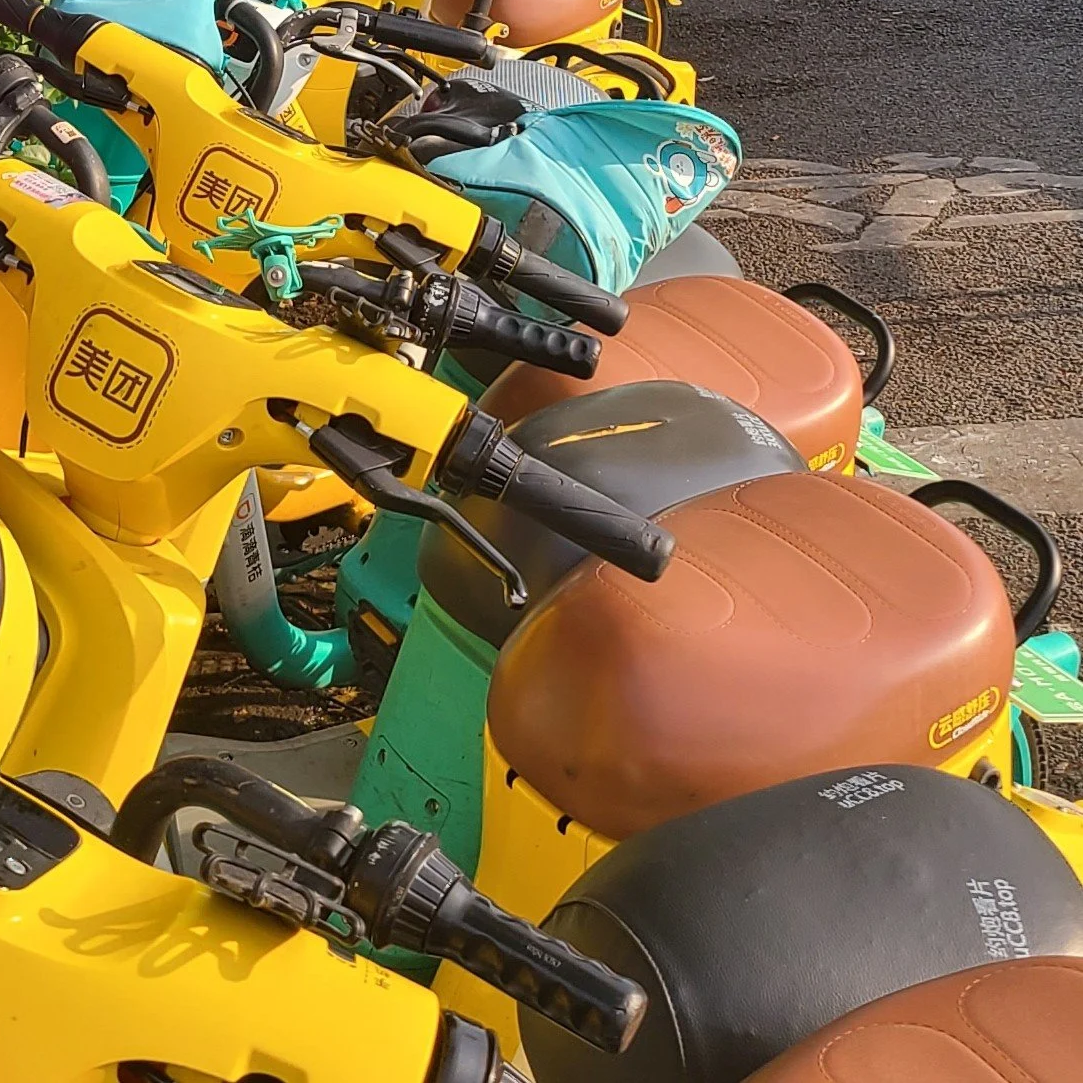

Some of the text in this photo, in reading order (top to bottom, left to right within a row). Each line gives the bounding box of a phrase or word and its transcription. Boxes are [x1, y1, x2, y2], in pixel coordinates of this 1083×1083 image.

[192, 170, 264, 219] 美团
[65, 338, 154, 414] 美团
[239, 521, 263, 583] 滴滴青桔
